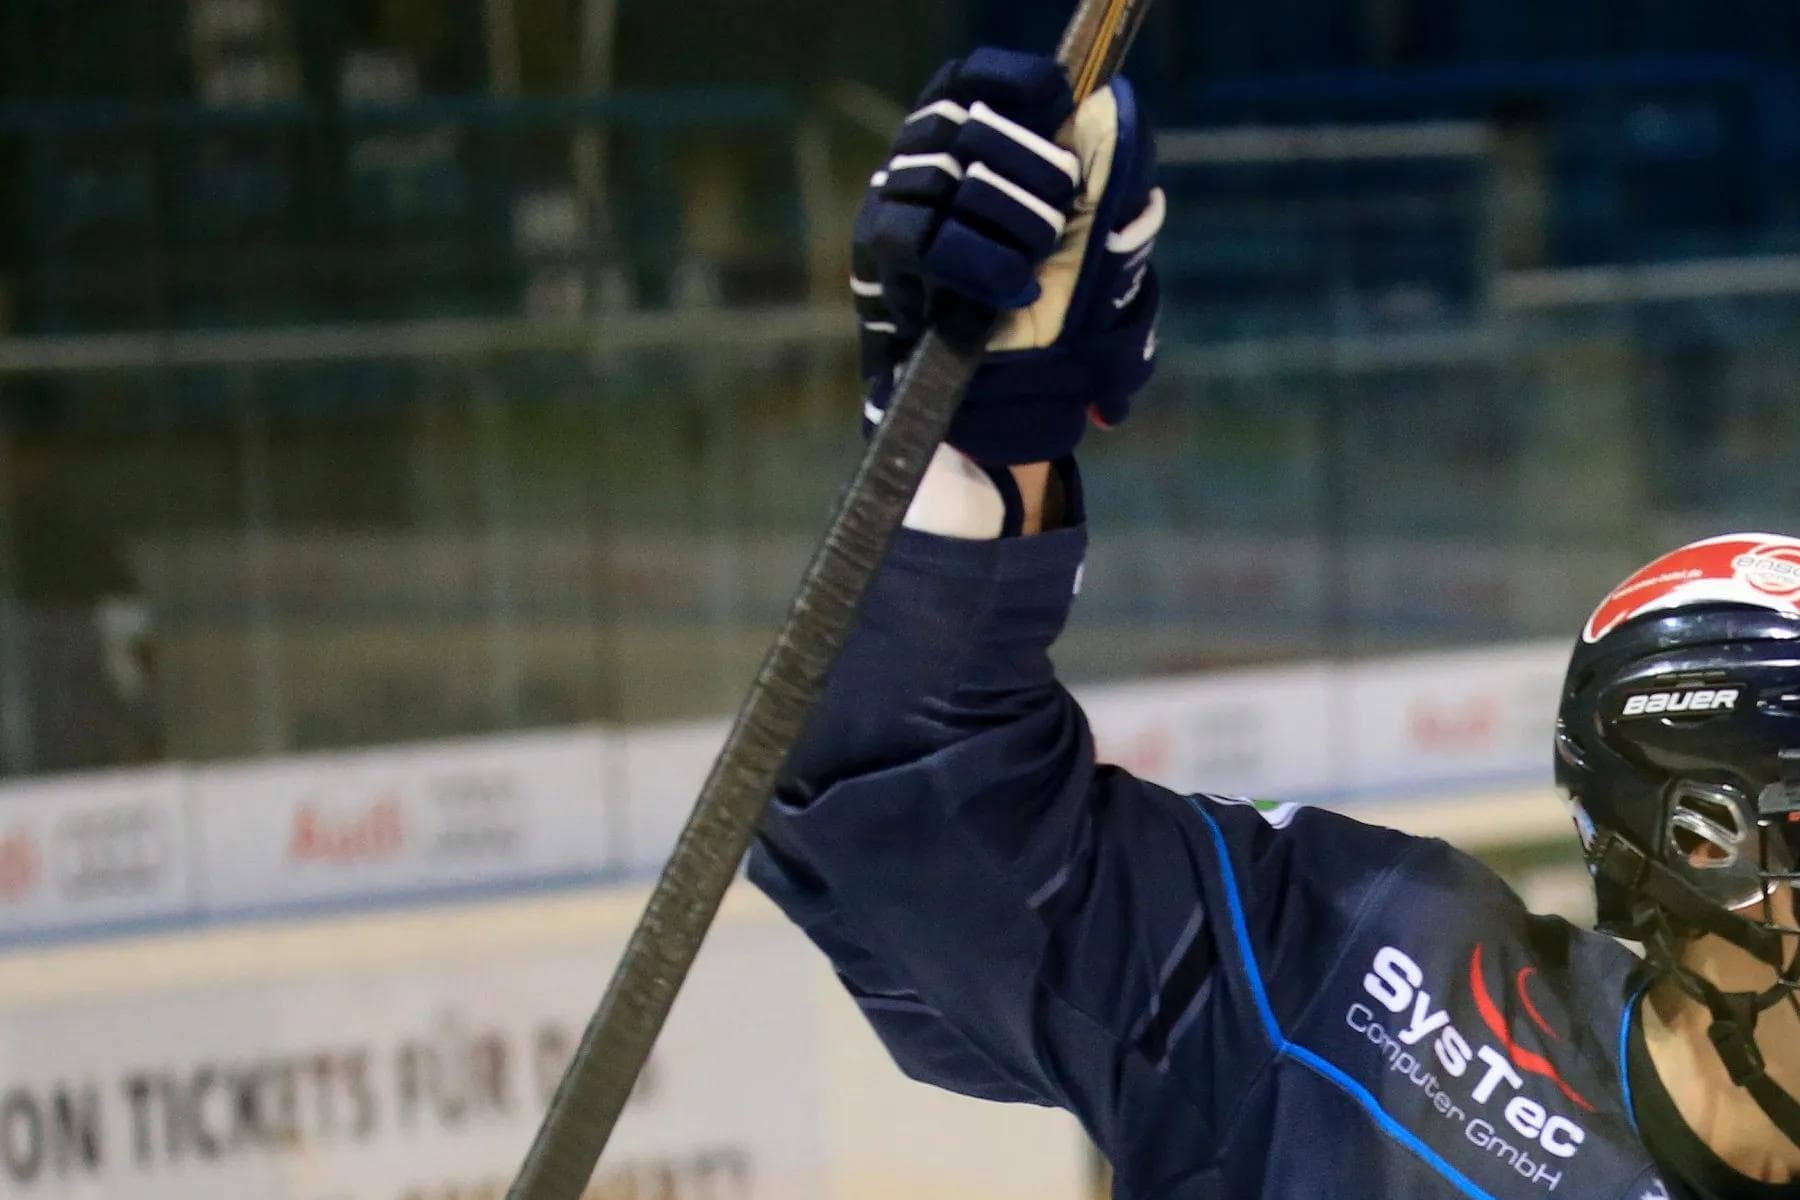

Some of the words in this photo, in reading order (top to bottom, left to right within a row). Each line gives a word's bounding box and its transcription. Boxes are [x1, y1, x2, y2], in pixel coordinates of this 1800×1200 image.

[1622, 689, 1739, 716] BAUER
[122, 1042, 375, 1172] TICKETS
[1344, 1003, 1467, 1124] Computer
[1465, 1118, 1562, 1191] GmbH
